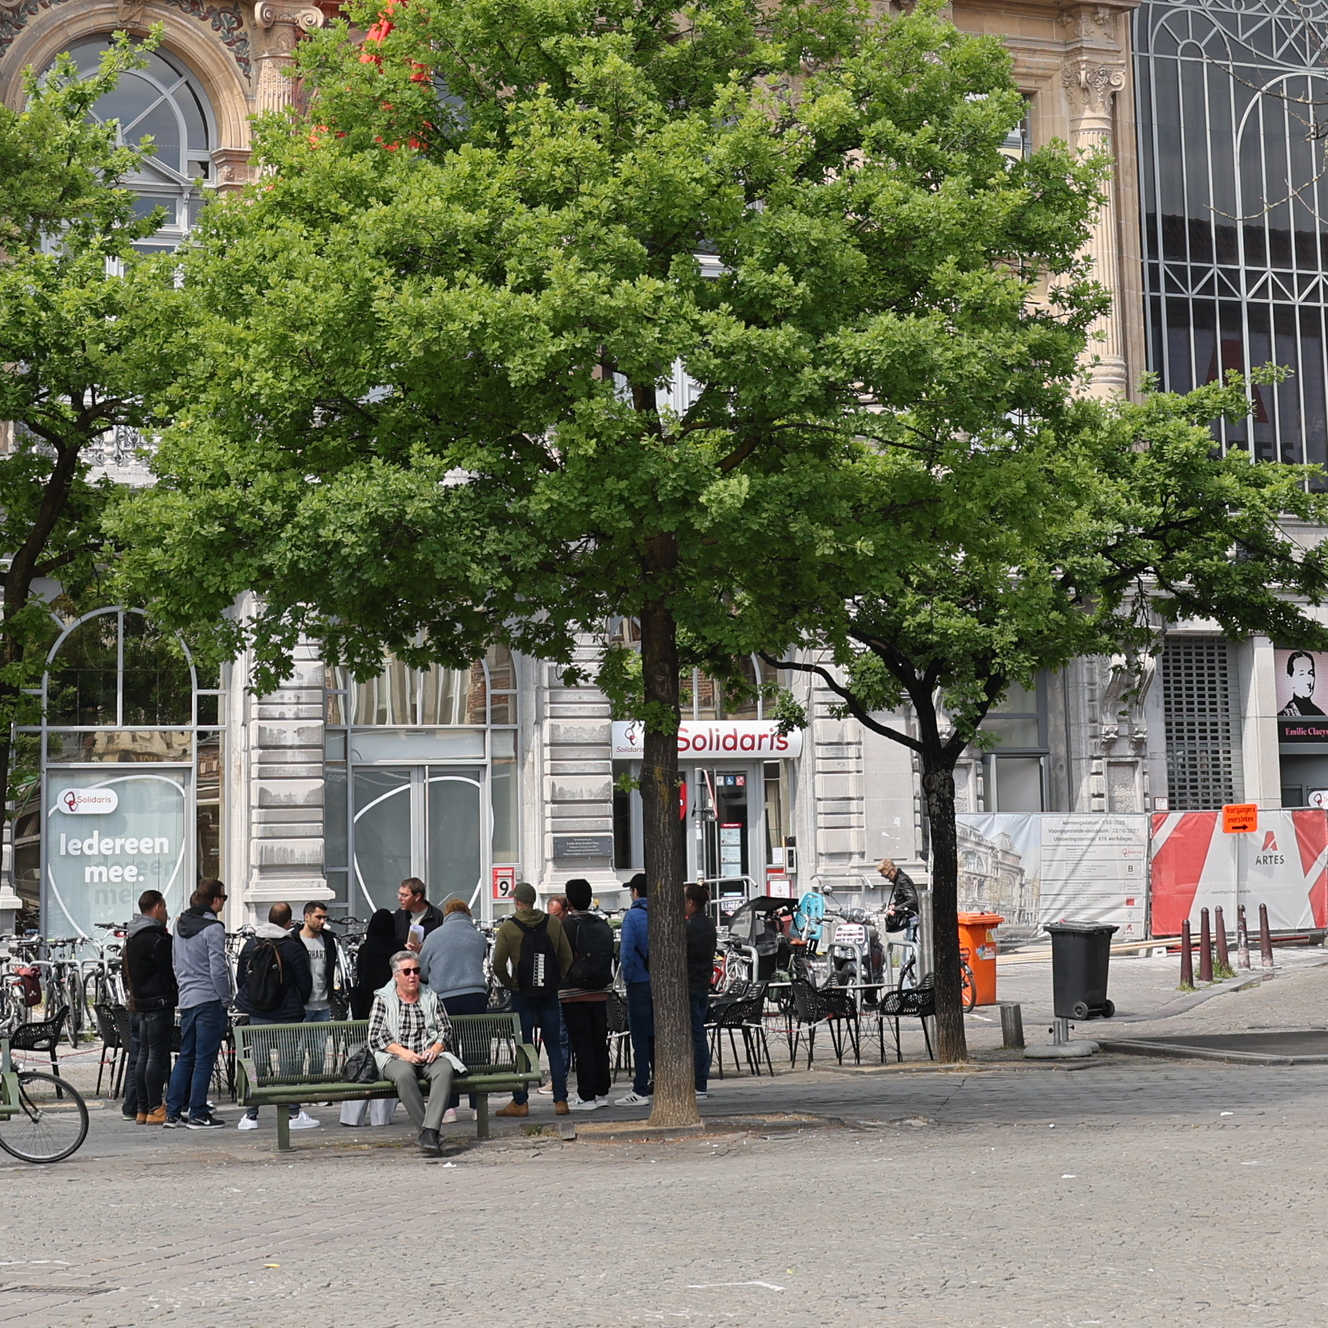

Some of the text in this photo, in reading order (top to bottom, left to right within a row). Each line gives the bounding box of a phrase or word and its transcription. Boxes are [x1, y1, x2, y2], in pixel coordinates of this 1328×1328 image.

[1285, 728, 1306, 736] Emilie
[678, 728, 789, 752] Solidaris
[77, 796, 112, 804] Solidaris
[59, 830, 169, 856] Iedereen
[1256, 855, 1284, 865] ARTES
[84, 864, 144, 883] mee.
[499, 881, 509, 896] 9
